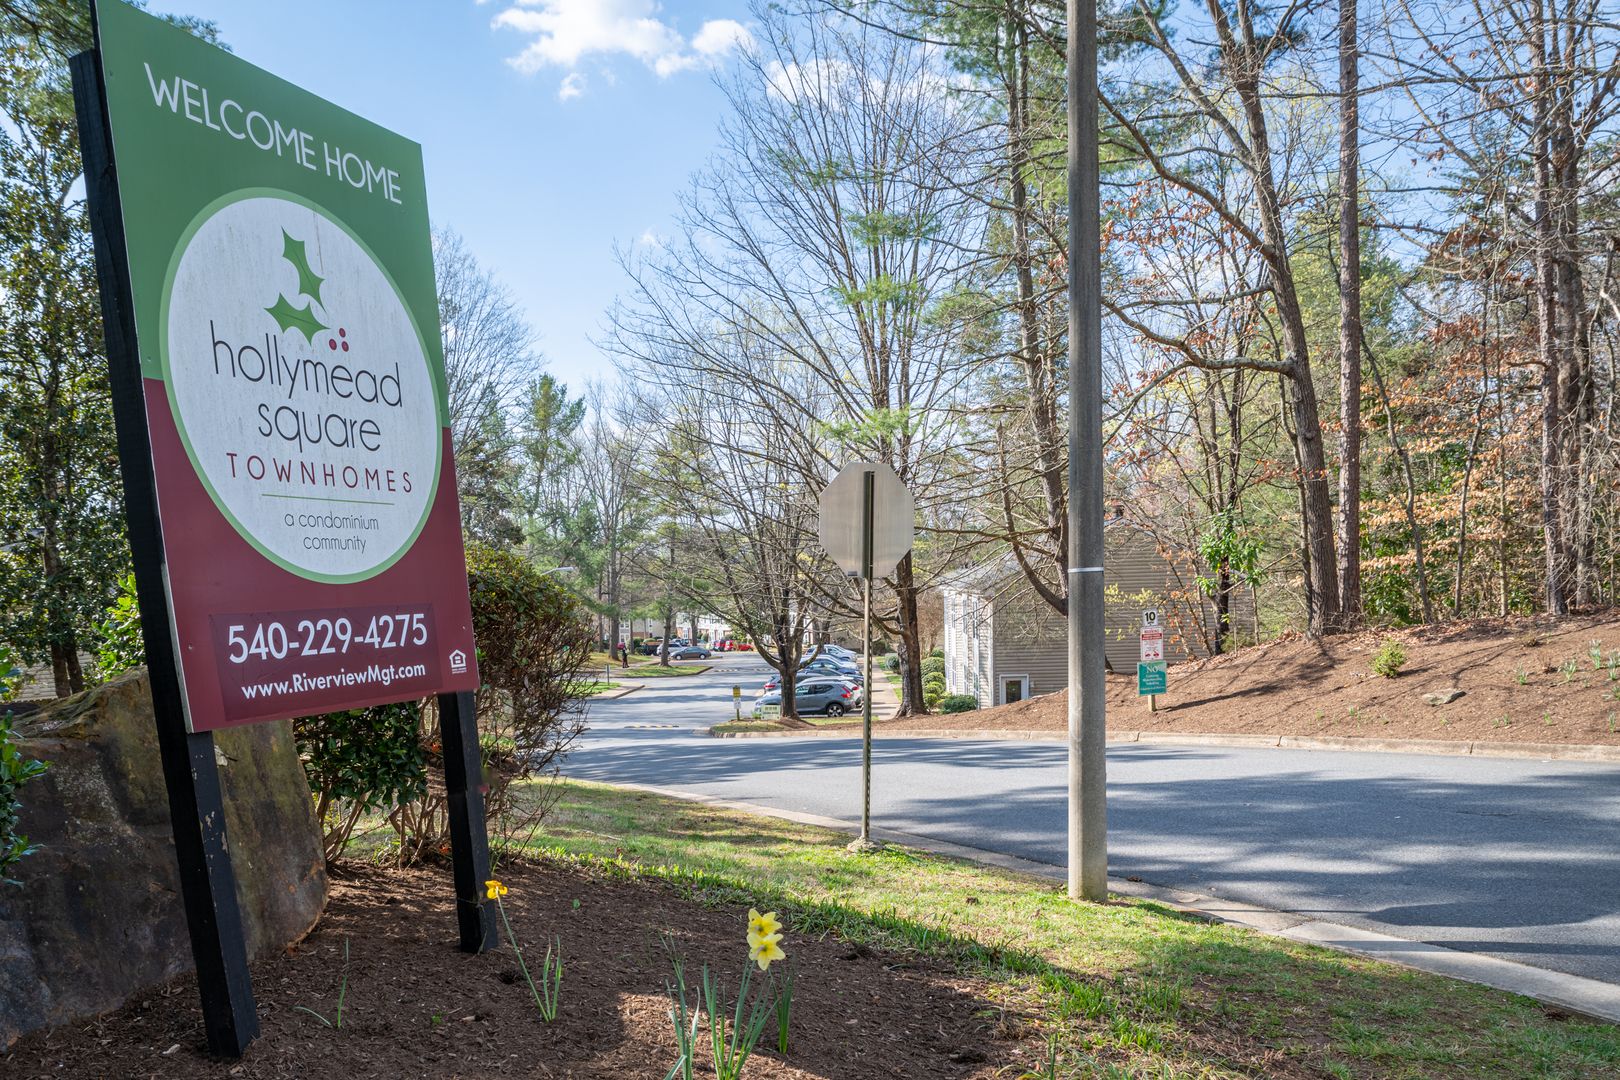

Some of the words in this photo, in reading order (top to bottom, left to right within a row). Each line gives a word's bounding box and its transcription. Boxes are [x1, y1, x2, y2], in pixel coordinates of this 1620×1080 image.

[144, 62, 317, 170] WELCOME
[323, 141, 402, 204] HOME
[210, 319, 402, 407] hollymead
[257, 403, 381, 453] square
[226, 452, 412, 493] TOWNHOMES
[284, 512, 296, 527] a
[298, 511, 379, 530] condominium
[303, 536, 367, 554] community
[1144, 611, 1156, 622] 10
[228, 613, 428, 664] 540-229-4275
[241, 663, 426, 699] www.RiverviewMgt.com
